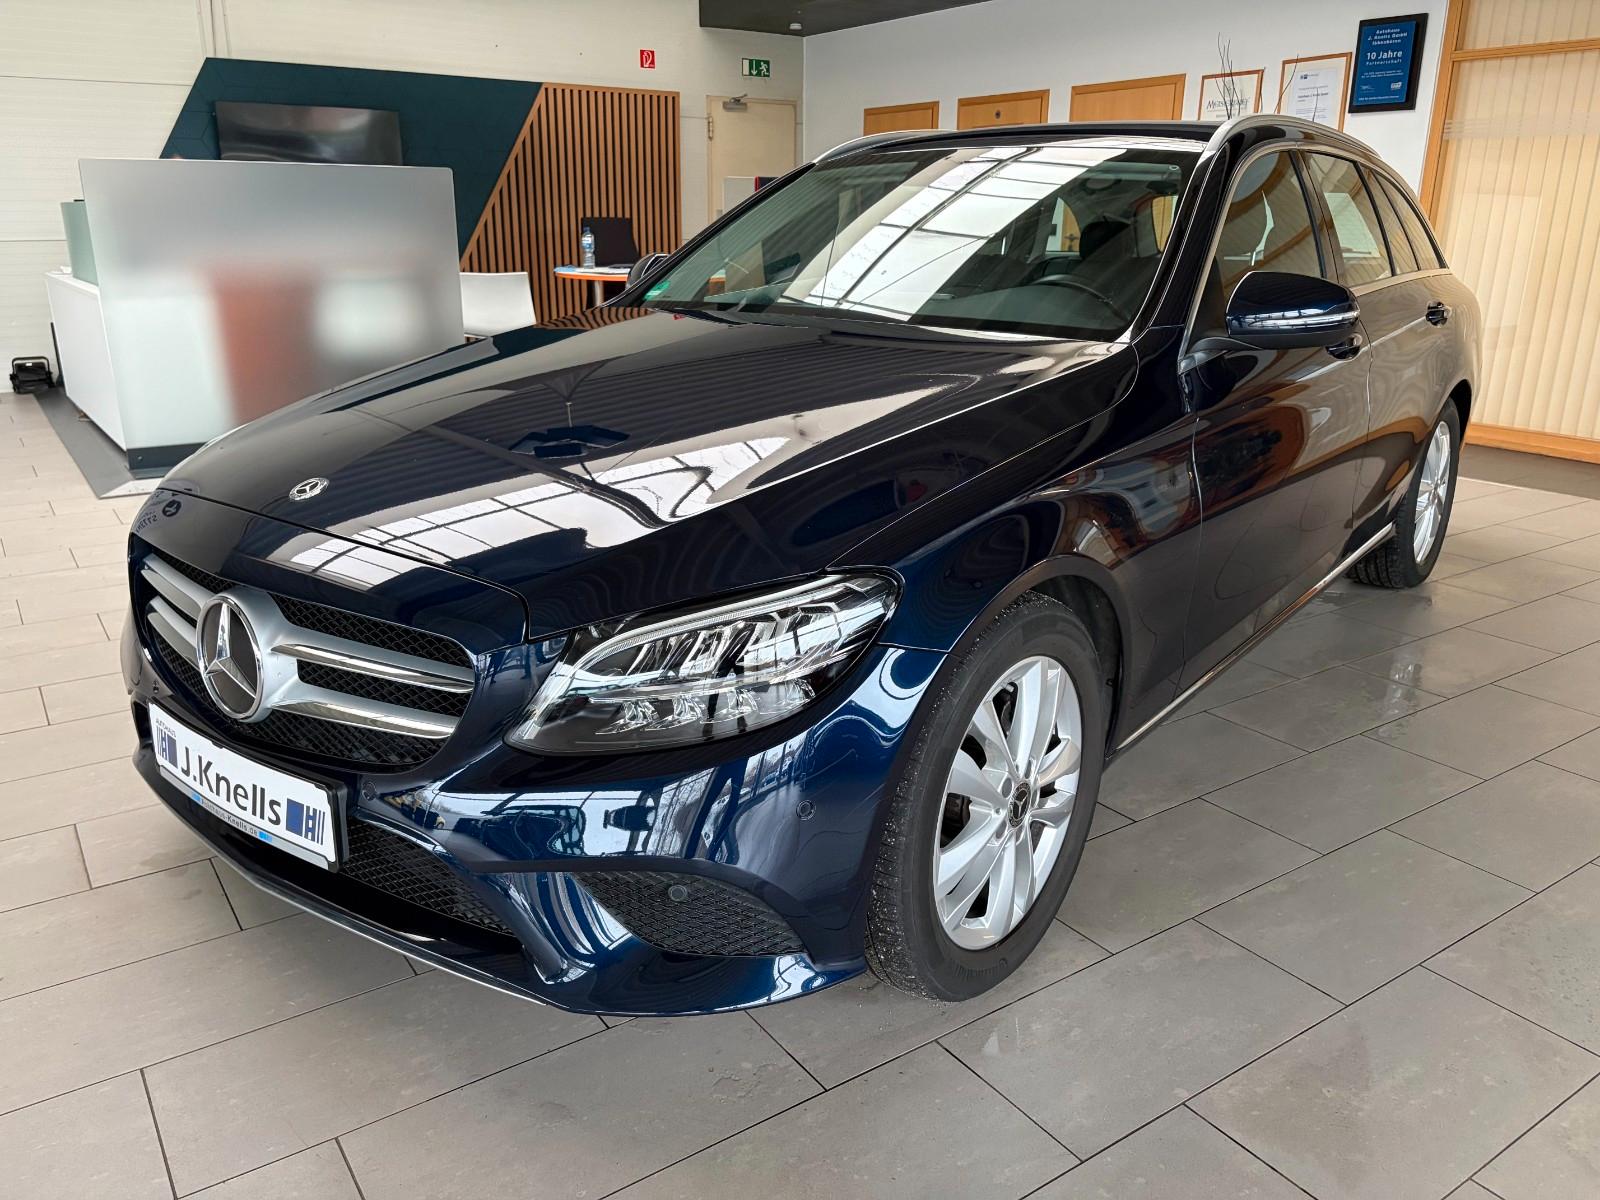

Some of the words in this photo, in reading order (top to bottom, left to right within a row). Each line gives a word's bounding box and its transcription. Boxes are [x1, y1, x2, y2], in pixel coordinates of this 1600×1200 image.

[1366, 51, 1377, 60] 10
[1378, 50, 1403, 60] Jahre
[181, 746, 282, 826] J.Knells
